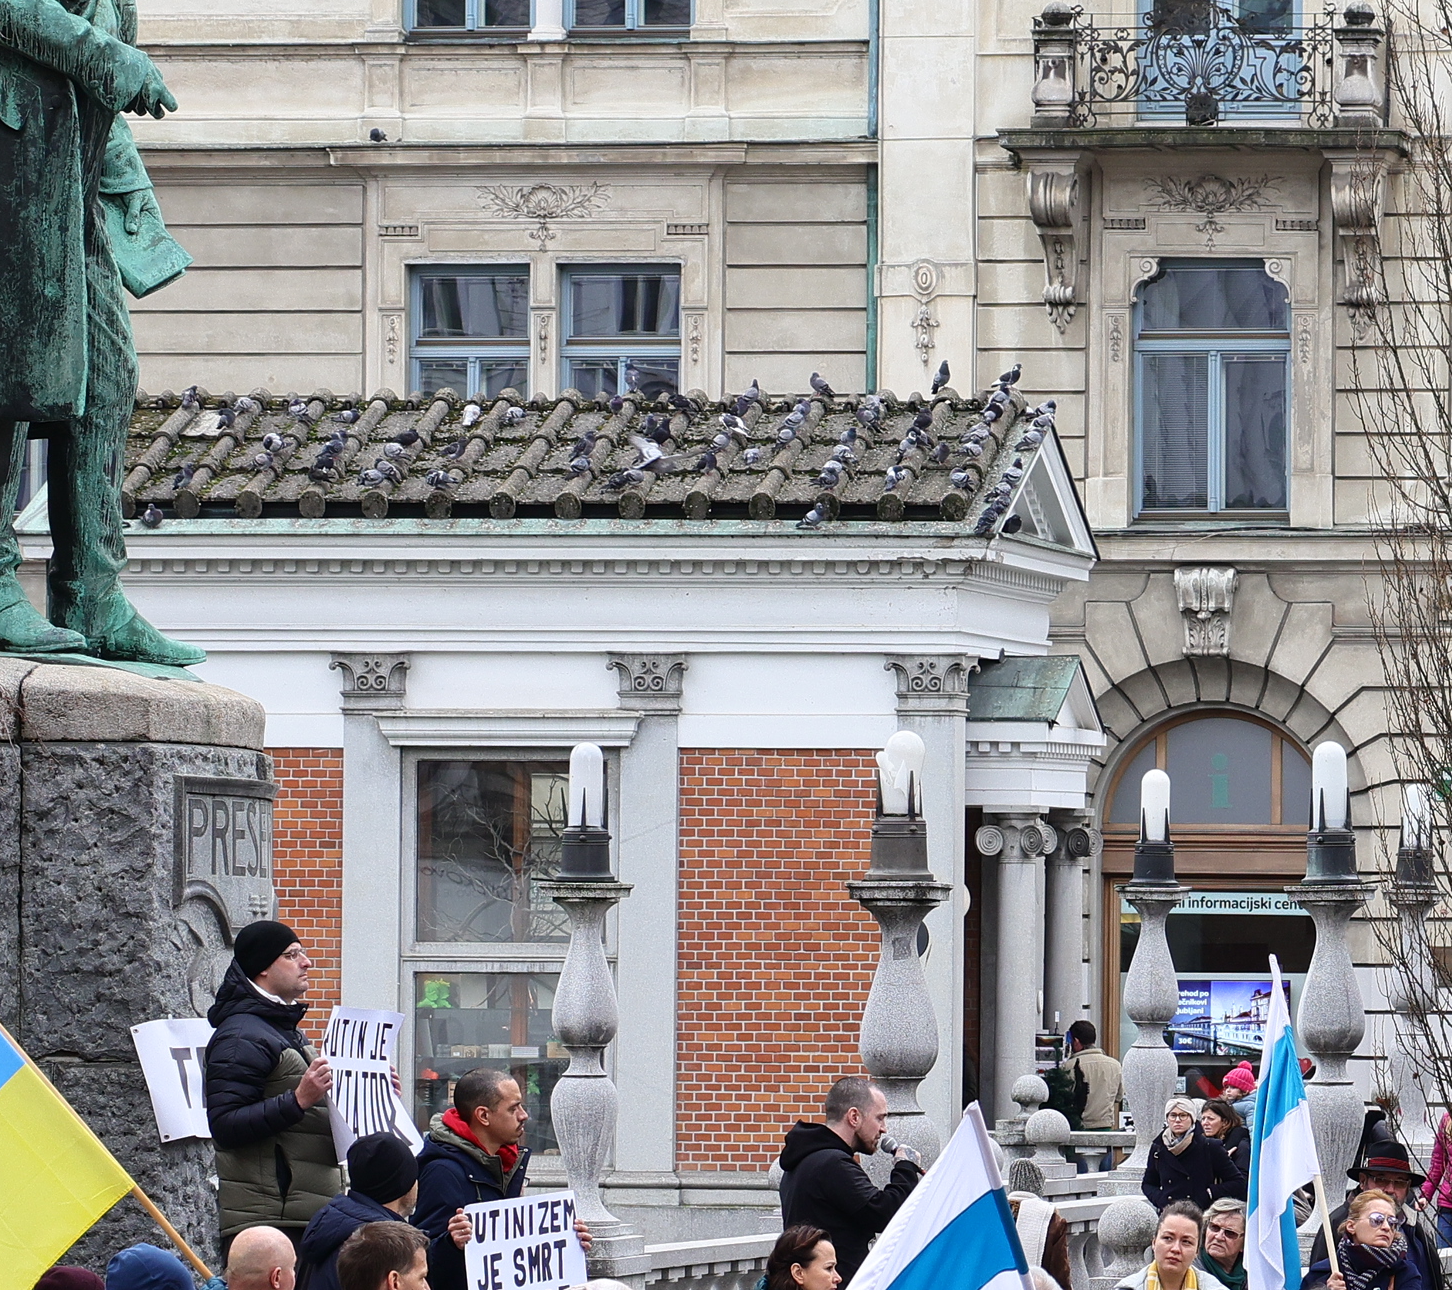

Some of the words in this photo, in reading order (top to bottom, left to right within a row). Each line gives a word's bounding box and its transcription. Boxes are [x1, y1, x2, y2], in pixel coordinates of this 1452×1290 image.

[188, 798, 270, 878] PREŠE
[1188, 896, 1272, 912] informacijski
[1276, 897, 1304, 911] cent
[370, 1022, 393, 1061] JE
[513, 1239, 566, 1287] SMRT
